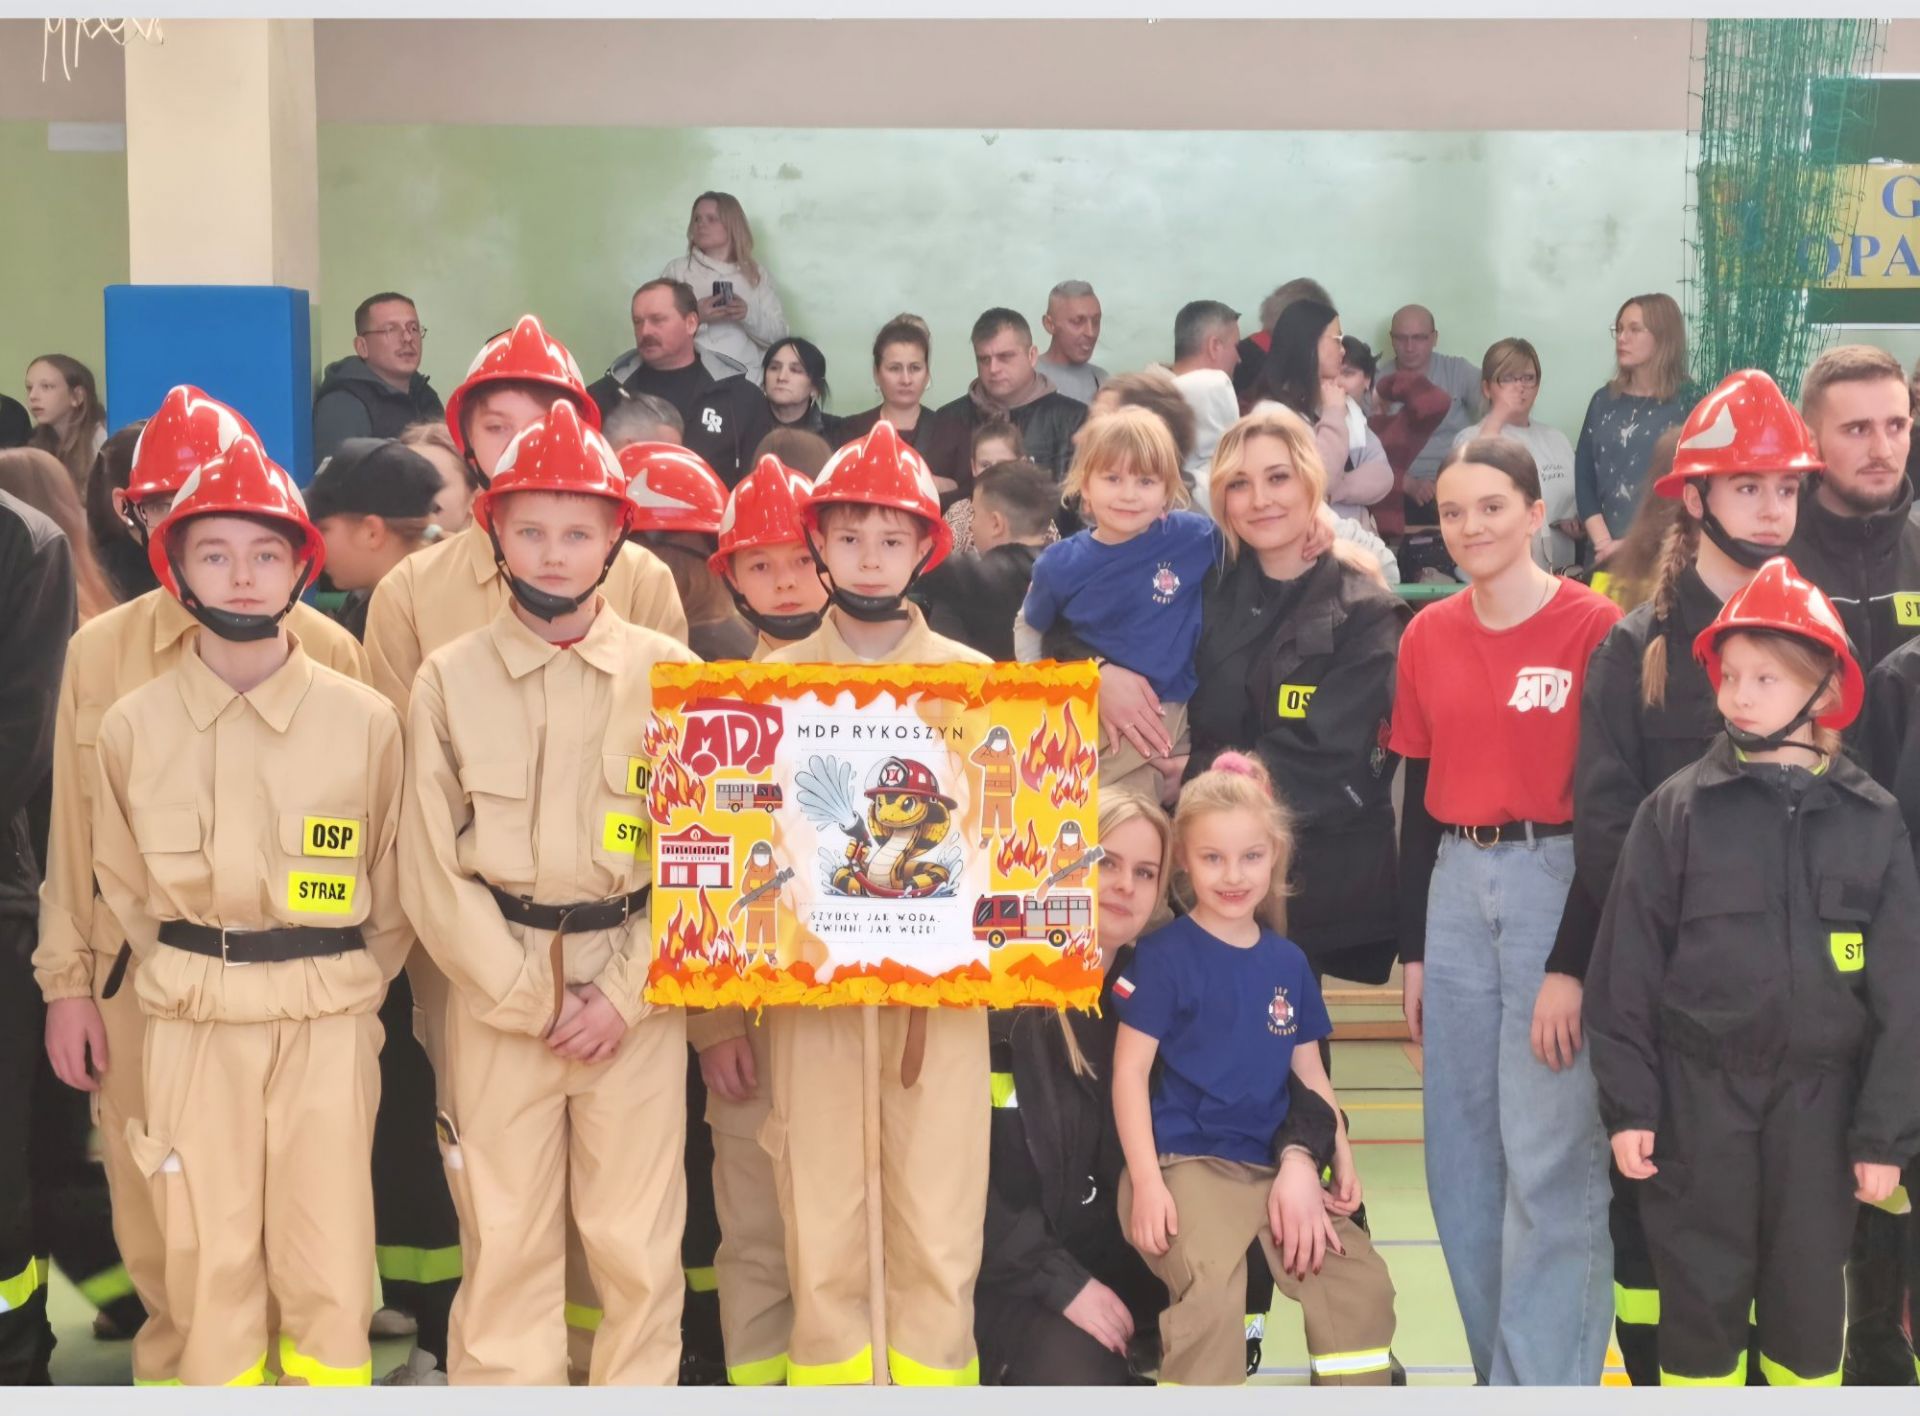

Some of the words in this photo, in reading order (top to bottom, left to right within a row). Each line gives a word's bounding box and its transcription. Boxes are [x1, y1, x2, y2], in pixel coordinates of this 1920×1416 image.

[798, 724, 840, 739] MDP
[852, 725, 963, 740] RYKOSZYN
[312, 823, 353, 850] OSP
